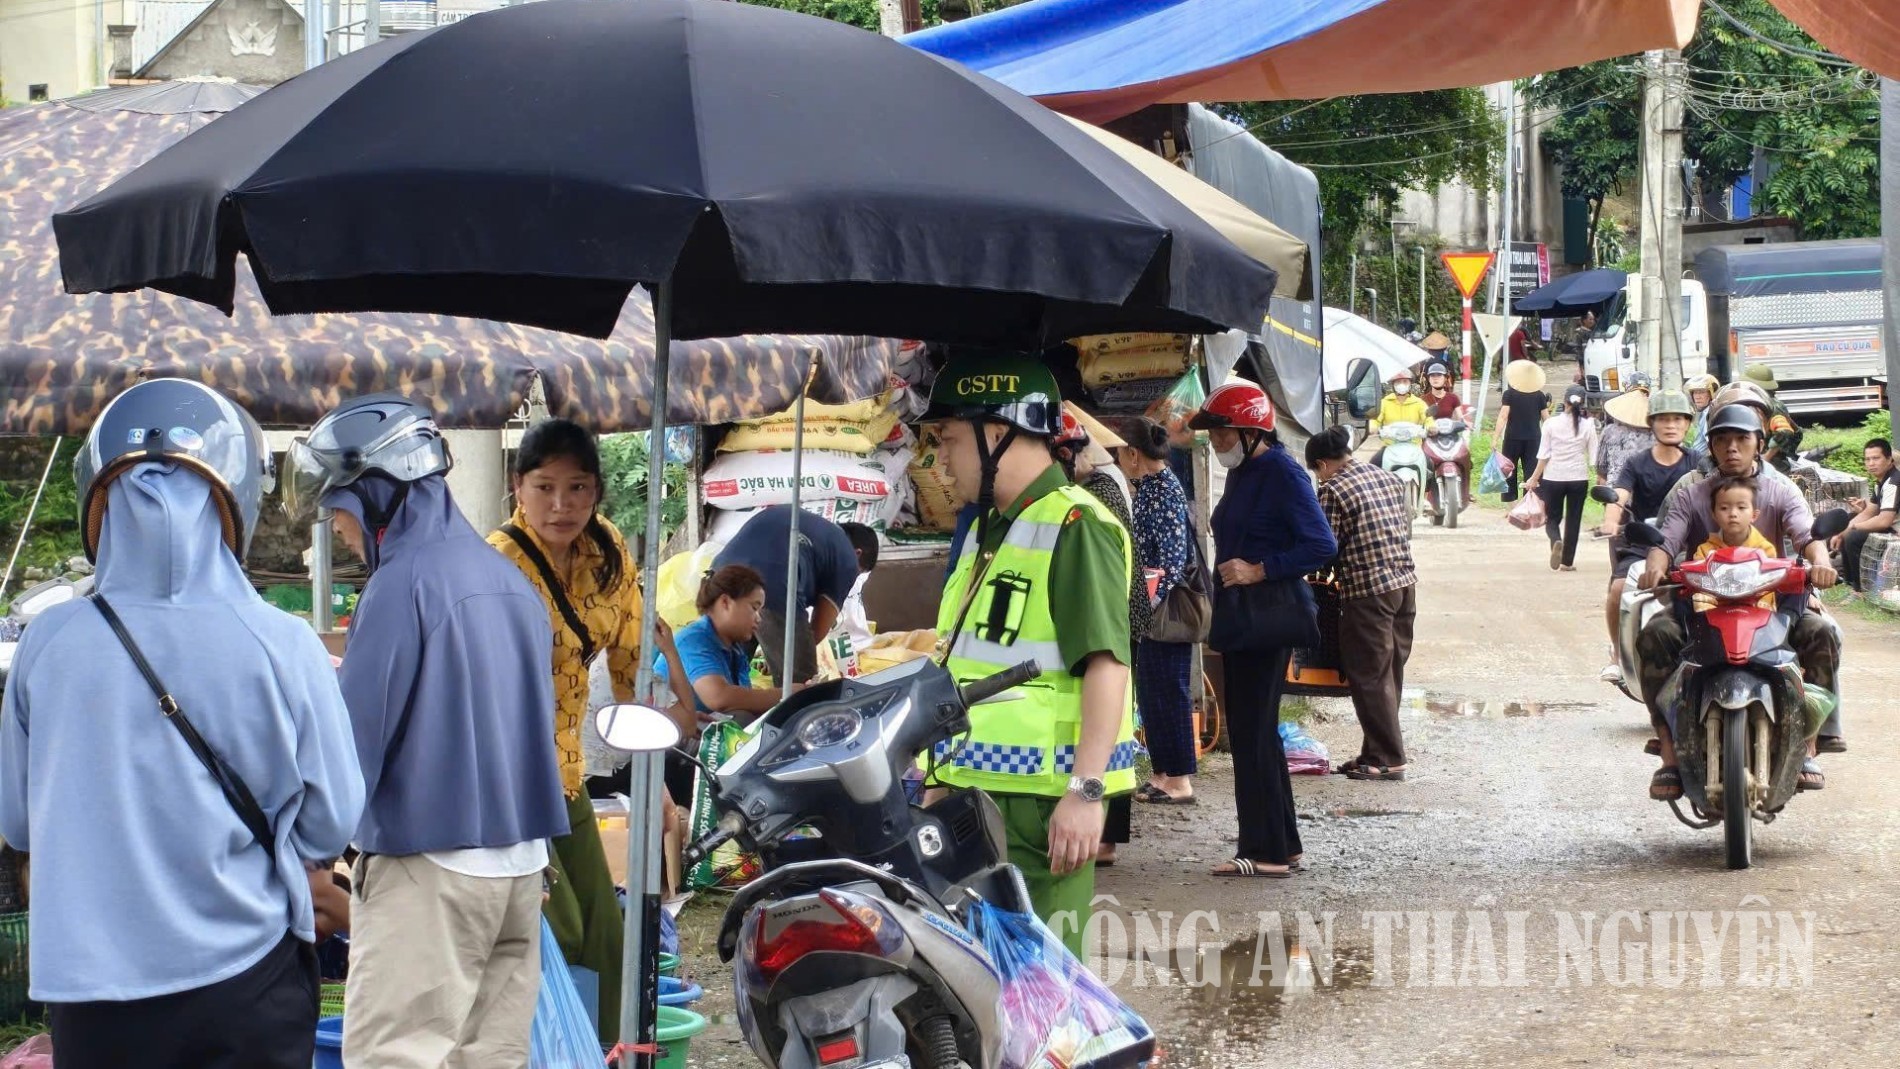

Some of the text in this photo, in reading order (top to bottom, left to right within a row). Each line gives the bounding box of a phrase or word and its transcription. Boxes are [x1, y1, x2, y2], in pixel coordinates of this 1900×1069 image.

[957, 374, 1020, 395] CSTT
[767, 477, 785, 492] HÀ
[847, 480, 878, 495] UREA
[772, 903, 822, 918] HONDA
